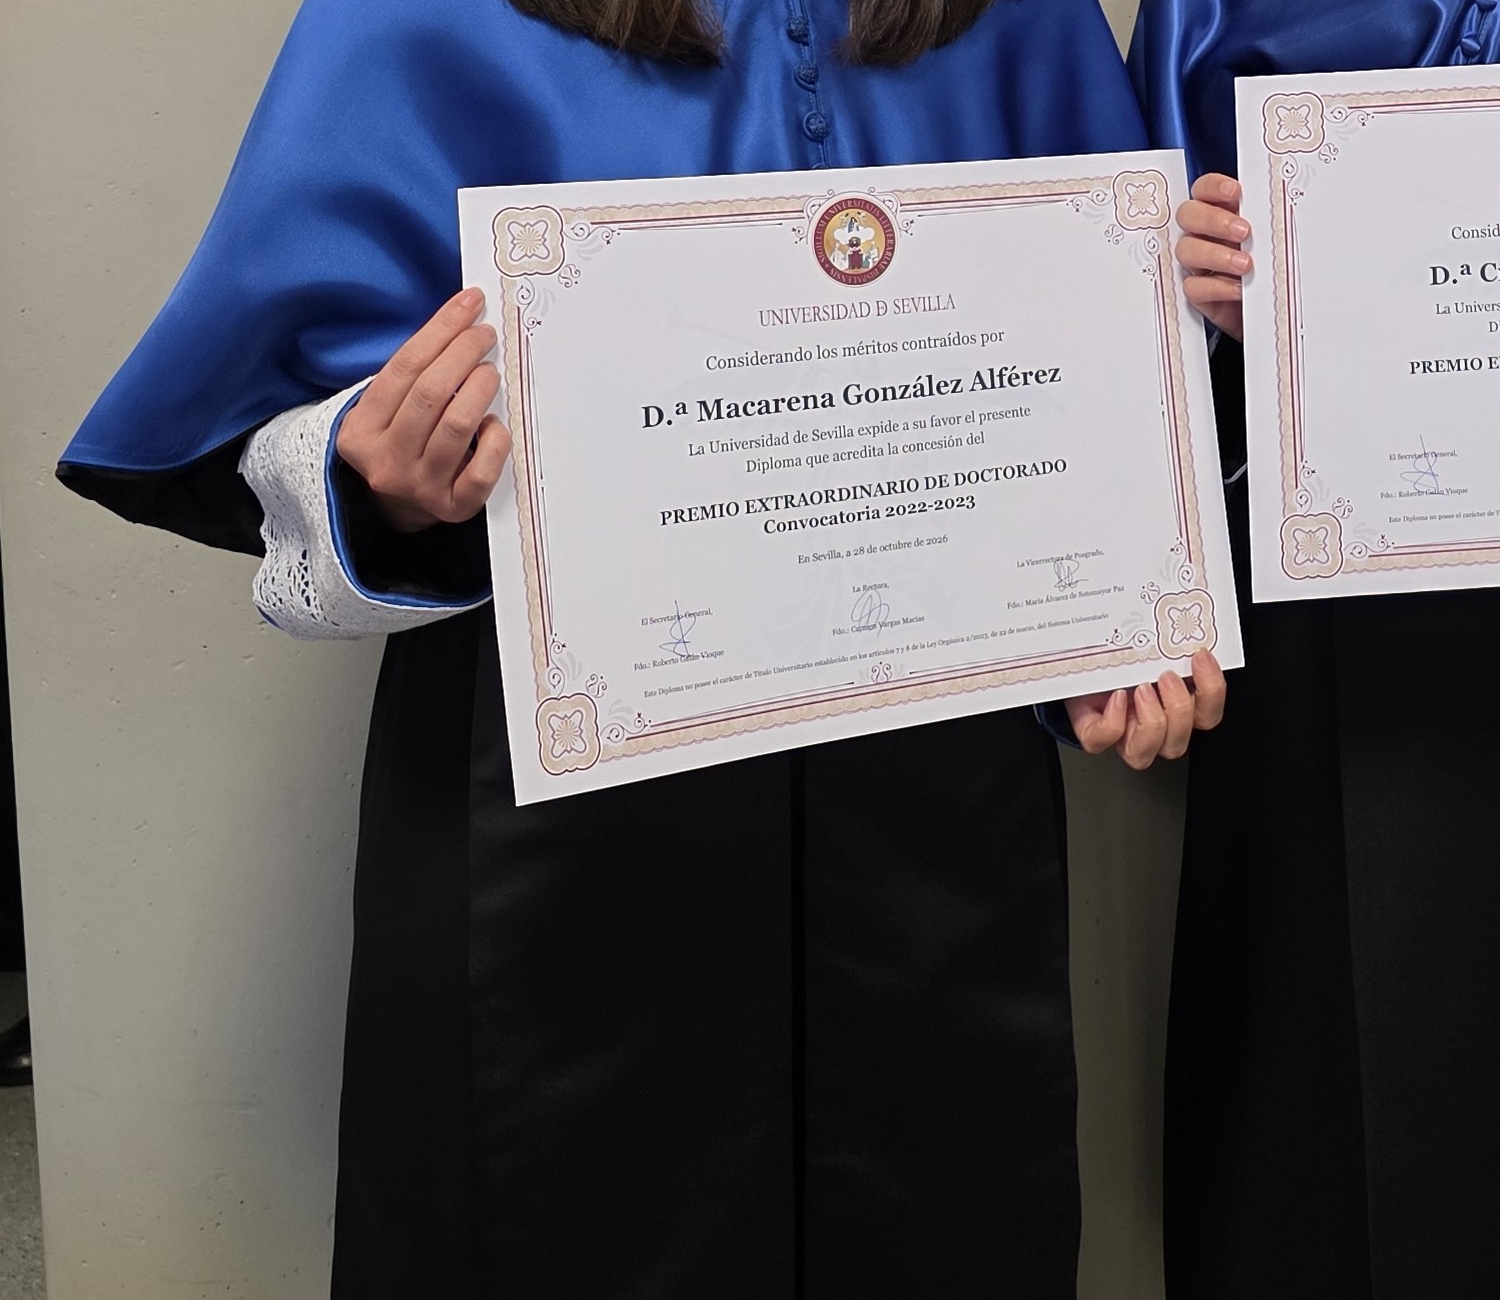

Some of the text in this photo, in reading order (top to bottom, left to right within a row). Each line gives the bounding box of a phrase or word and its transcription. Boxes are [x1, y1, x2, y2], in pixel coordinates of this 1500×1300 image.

[759, 301, 871, 327] UNIVERSIDAD
[892, 293, 956, 315] SEVILLA
[1435, 303, 1451, 315] La
[705, 331, 1005, 371] Considerando los méritos contraídos por
[1409, 357, 1483, 375] PREMIO
[695, 392, 836, 423] Macarena
[842, 374, 964, 406] González
[968, 365, 1062, 393] Alférez
[688, 406, 1031, 457] La Universidad de Sevilla expide a su favor el presente
[746, 430, 985, 475] Diploma que acredita la concesión del
[659, 458, 1067, 526] PREMIO EXTRAORDINARIO DE DOCTORADO
[763, 494, 976, 535] Convocatoria 2022-2023
[797, 533, 949, 565] En Sevilla, a 28 de octubre de 2026
